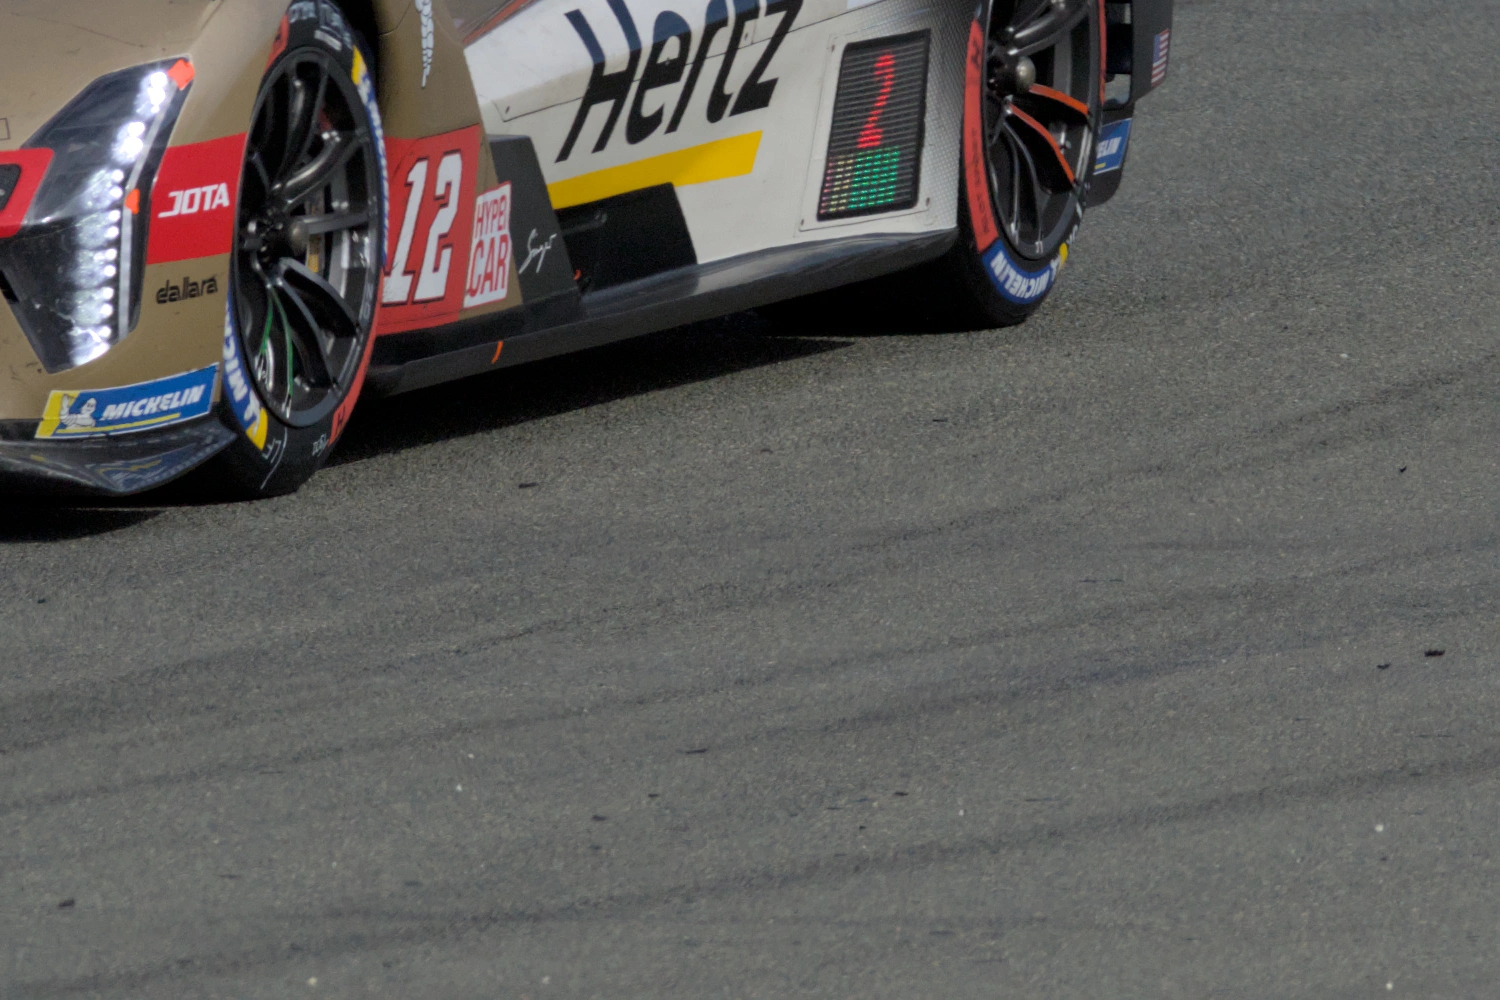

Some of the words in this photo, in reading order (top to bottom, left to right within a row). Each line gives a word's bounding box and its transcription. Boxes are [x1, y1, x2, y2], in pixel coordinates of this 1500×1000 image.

[157, 182, 230, 218] JOTA
[380, 149, 464, 307] 12
[466, 233, 509, 297] CAR
[990, 251, 1050, 299] MICHELIN
[156, 275, 218, 304] dallara
[99, 384, 206, 422] MICHELIN
